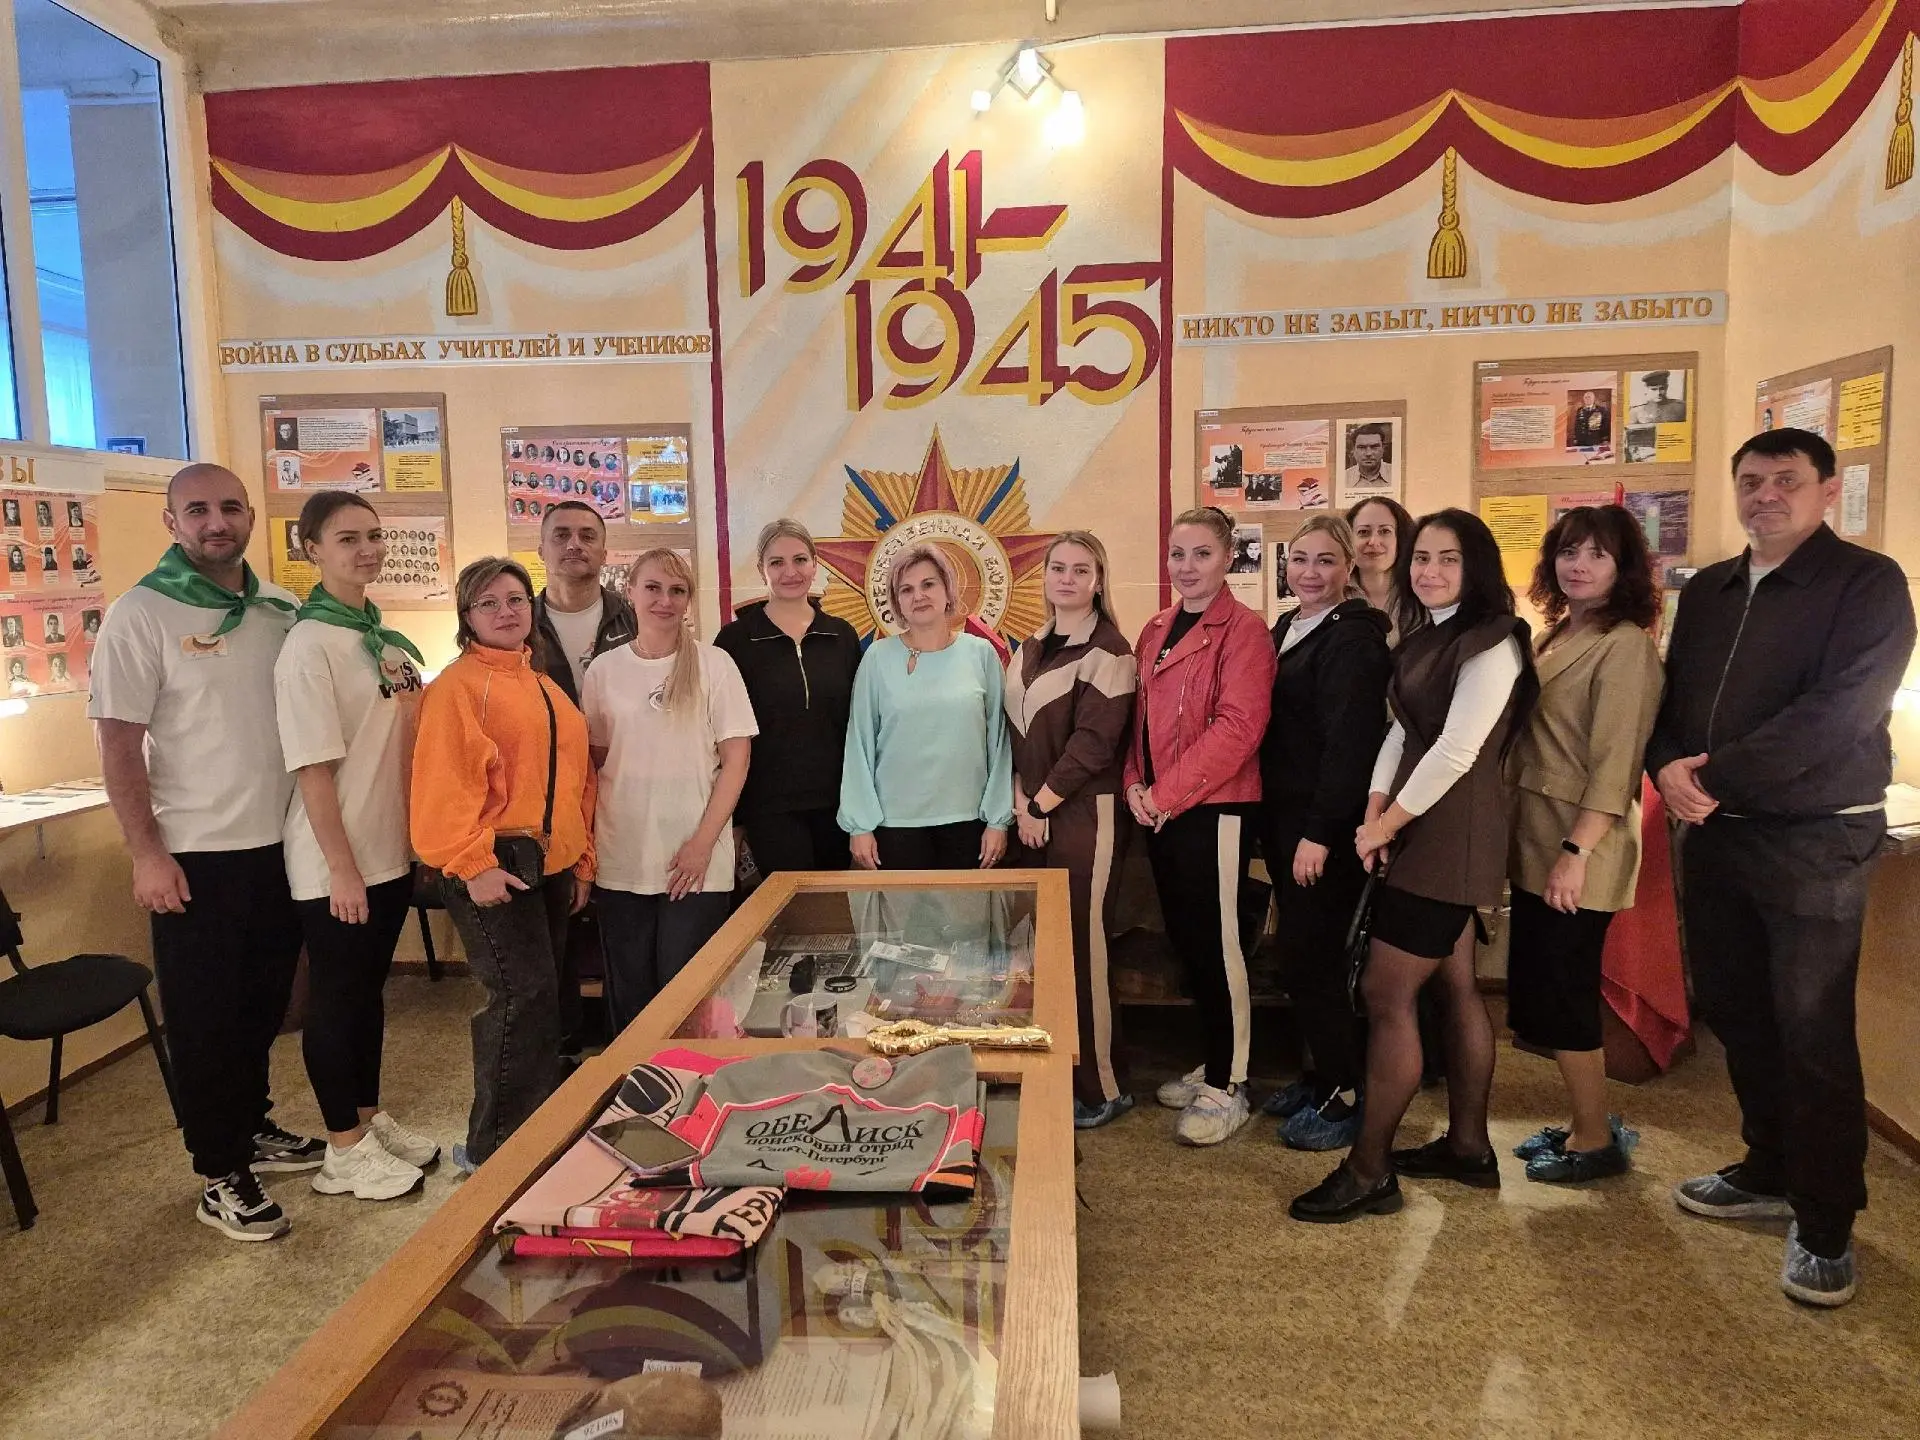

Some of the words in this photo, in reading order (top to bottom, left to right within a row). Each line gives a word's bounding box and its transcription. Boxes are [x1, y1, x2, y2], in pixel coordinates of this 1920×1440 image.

[844, 261, 1163, 411] 1945
[1182, 315, 1275, 340] НИКТО
[1284, 313, 1320, 335] НЕ
[1330, 308, 1434, 333] ЗАБЫТ,
[1441, 303, 1537, 328] НИЧТО
[1546, 302, 1583, 324] НЕ
[1594, 296, 1713, 321] ЗАБЫТО
[221, 341, 298, 365] ВОЙНА
[304, 343, 320, 363] В
[325, 341, 426, 364] СУДЬБАХ
[438, 333, 562, 360] УЧИТЕЛЕЙ
[567, 337, 585, 357] И
[592, 334, 712, 356] УЧЕНИКОВ
[0, 456, 36, 484] Ы
[745, 1104, 925, 1143] ОБЕЛИСК
